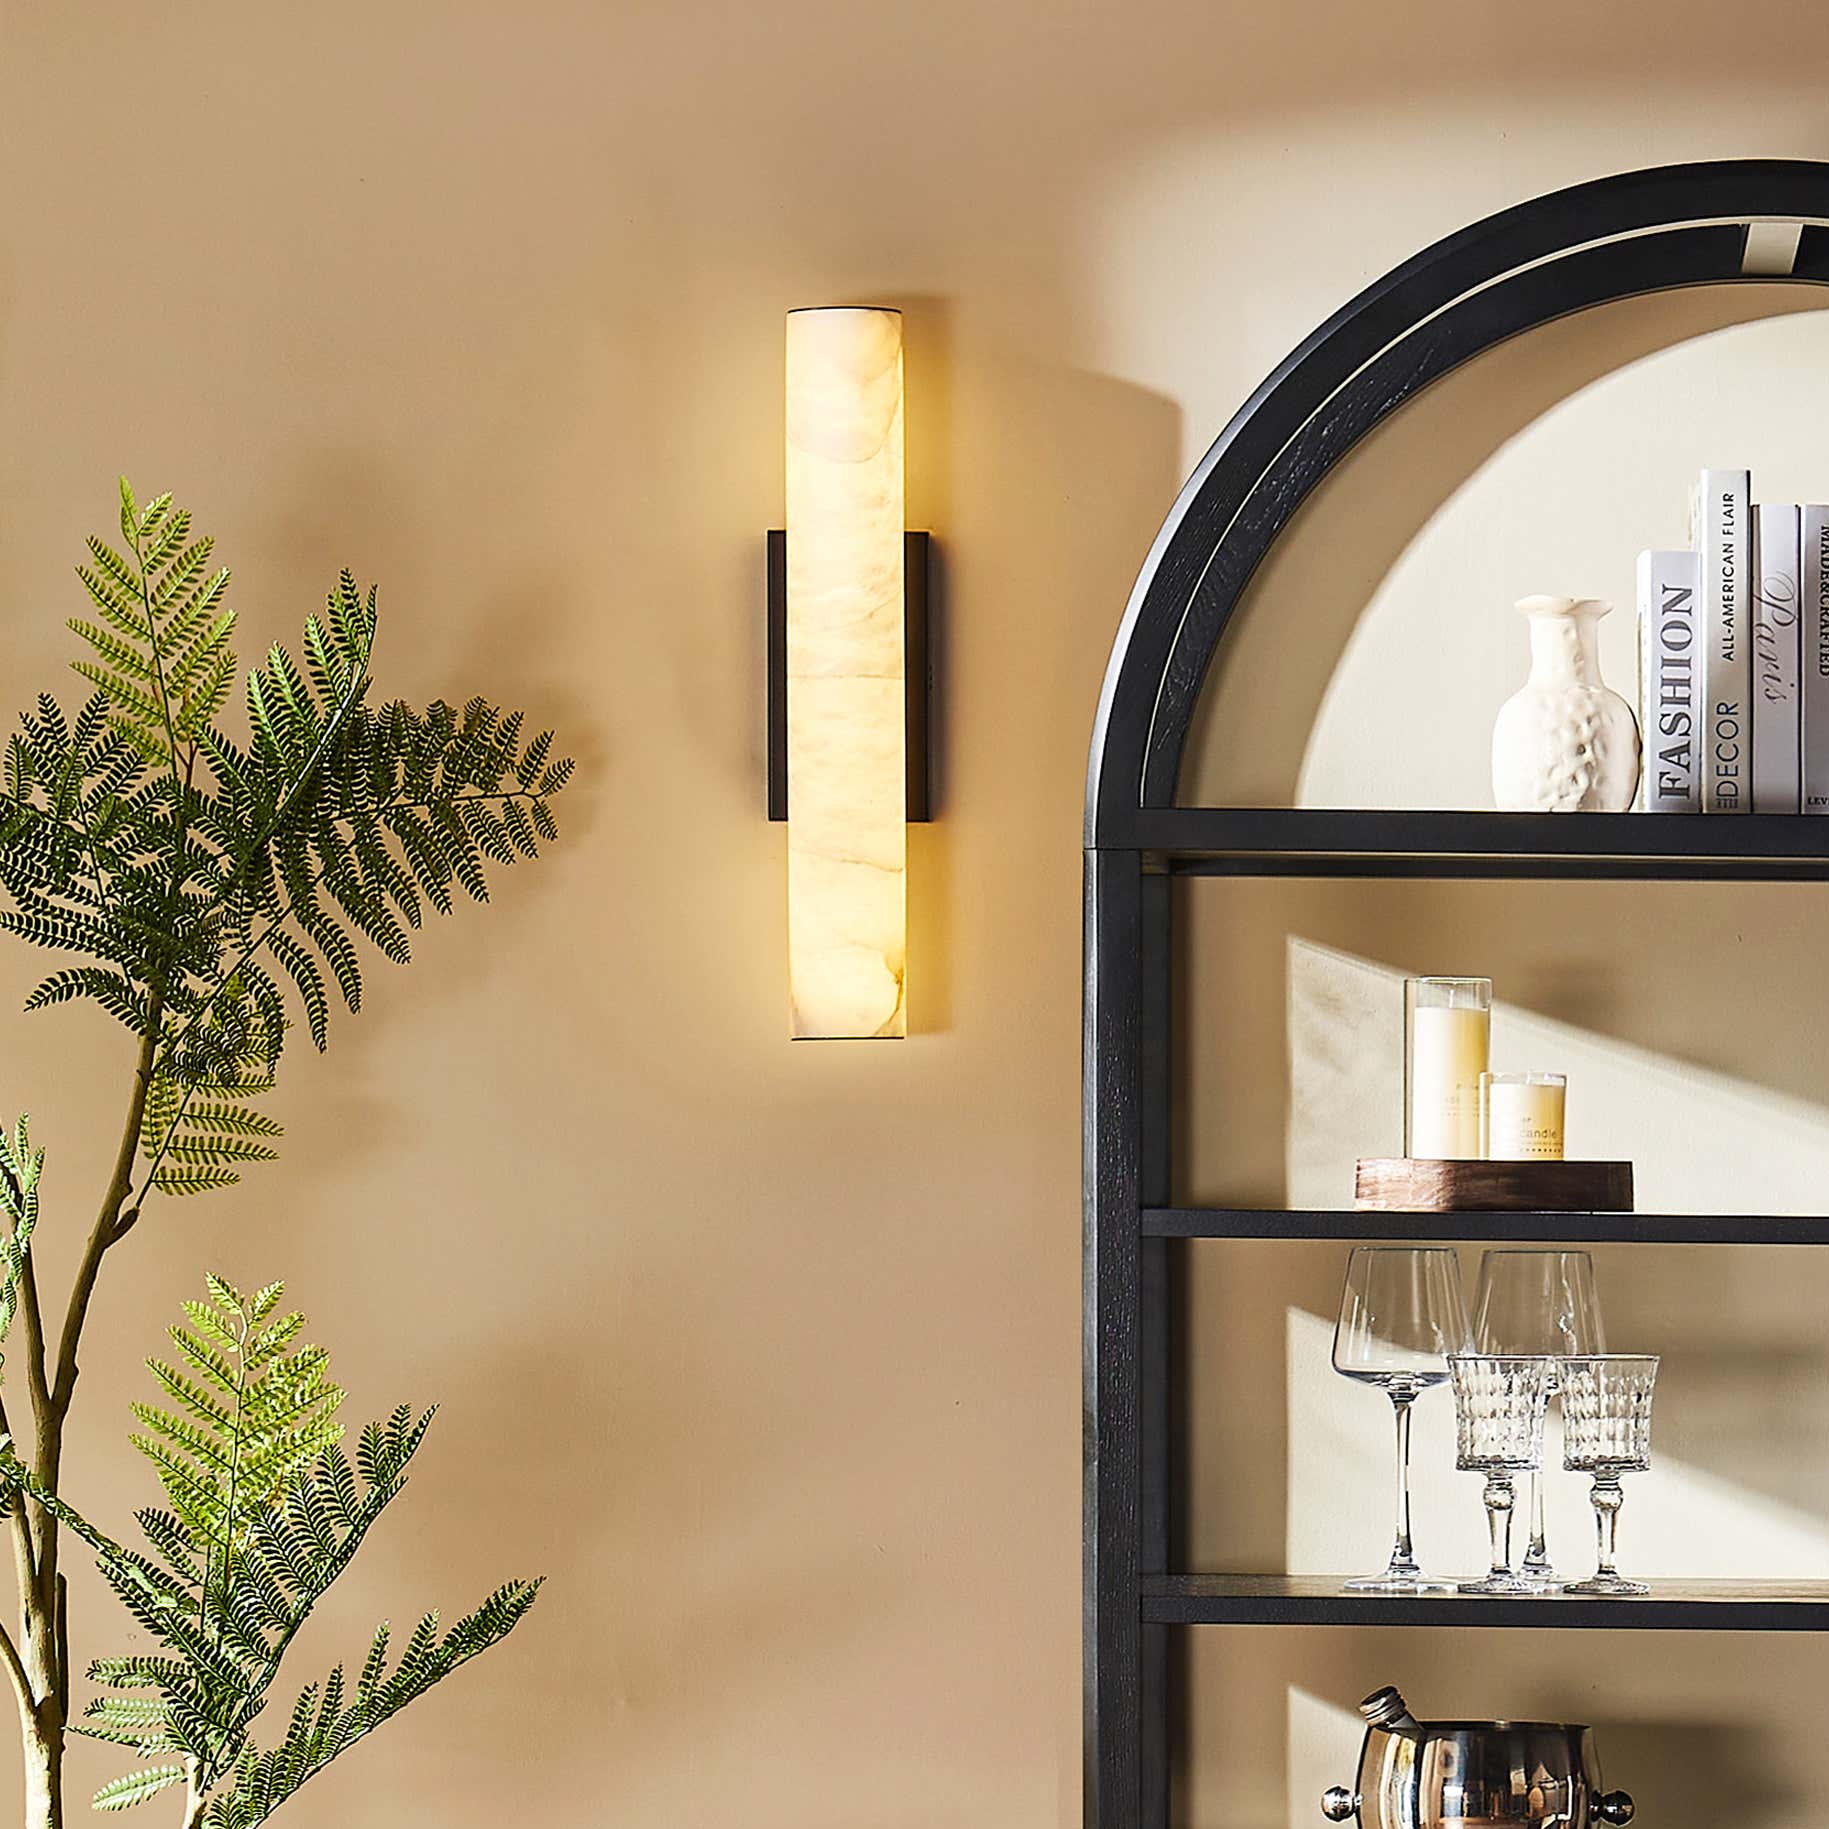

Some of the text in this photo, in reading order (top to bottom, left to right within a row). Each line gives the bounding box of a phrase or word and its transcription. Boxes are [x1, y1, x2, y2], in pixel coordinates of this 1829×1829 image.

[1722, 492, 1735, 662] ALL-AMERICAN FLAIR
[1752, 569, 1797, 704] Paris
[1659, 583, 1693, 800] FASHION
[1715, 702, 1739, 797] DECOR
